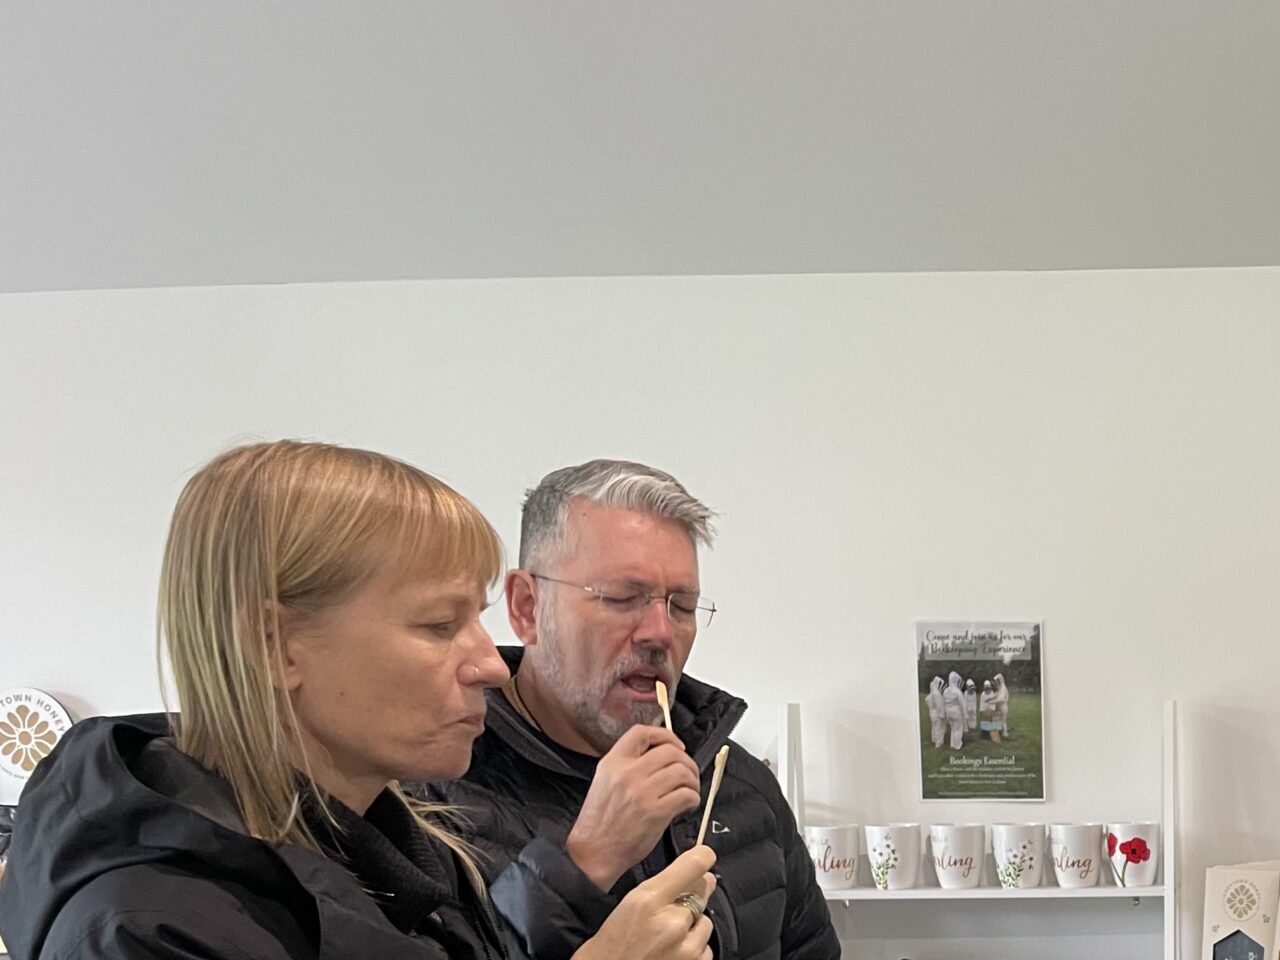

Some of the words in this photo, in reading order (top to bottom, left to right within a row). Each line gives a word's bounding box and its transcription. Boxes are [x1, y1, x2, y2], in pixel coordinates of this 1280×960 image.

[926, 630, 950, 641] Come
[953, 630, 969, 641] and
[930, 643, 978, 658] Beekeeping
[981, 643, 1026, 658] Experience
[36, 698, 66, 732] HONEY
[949, 756, 982, 768] Bookings
[983, 755, 1015, 765] Essential
